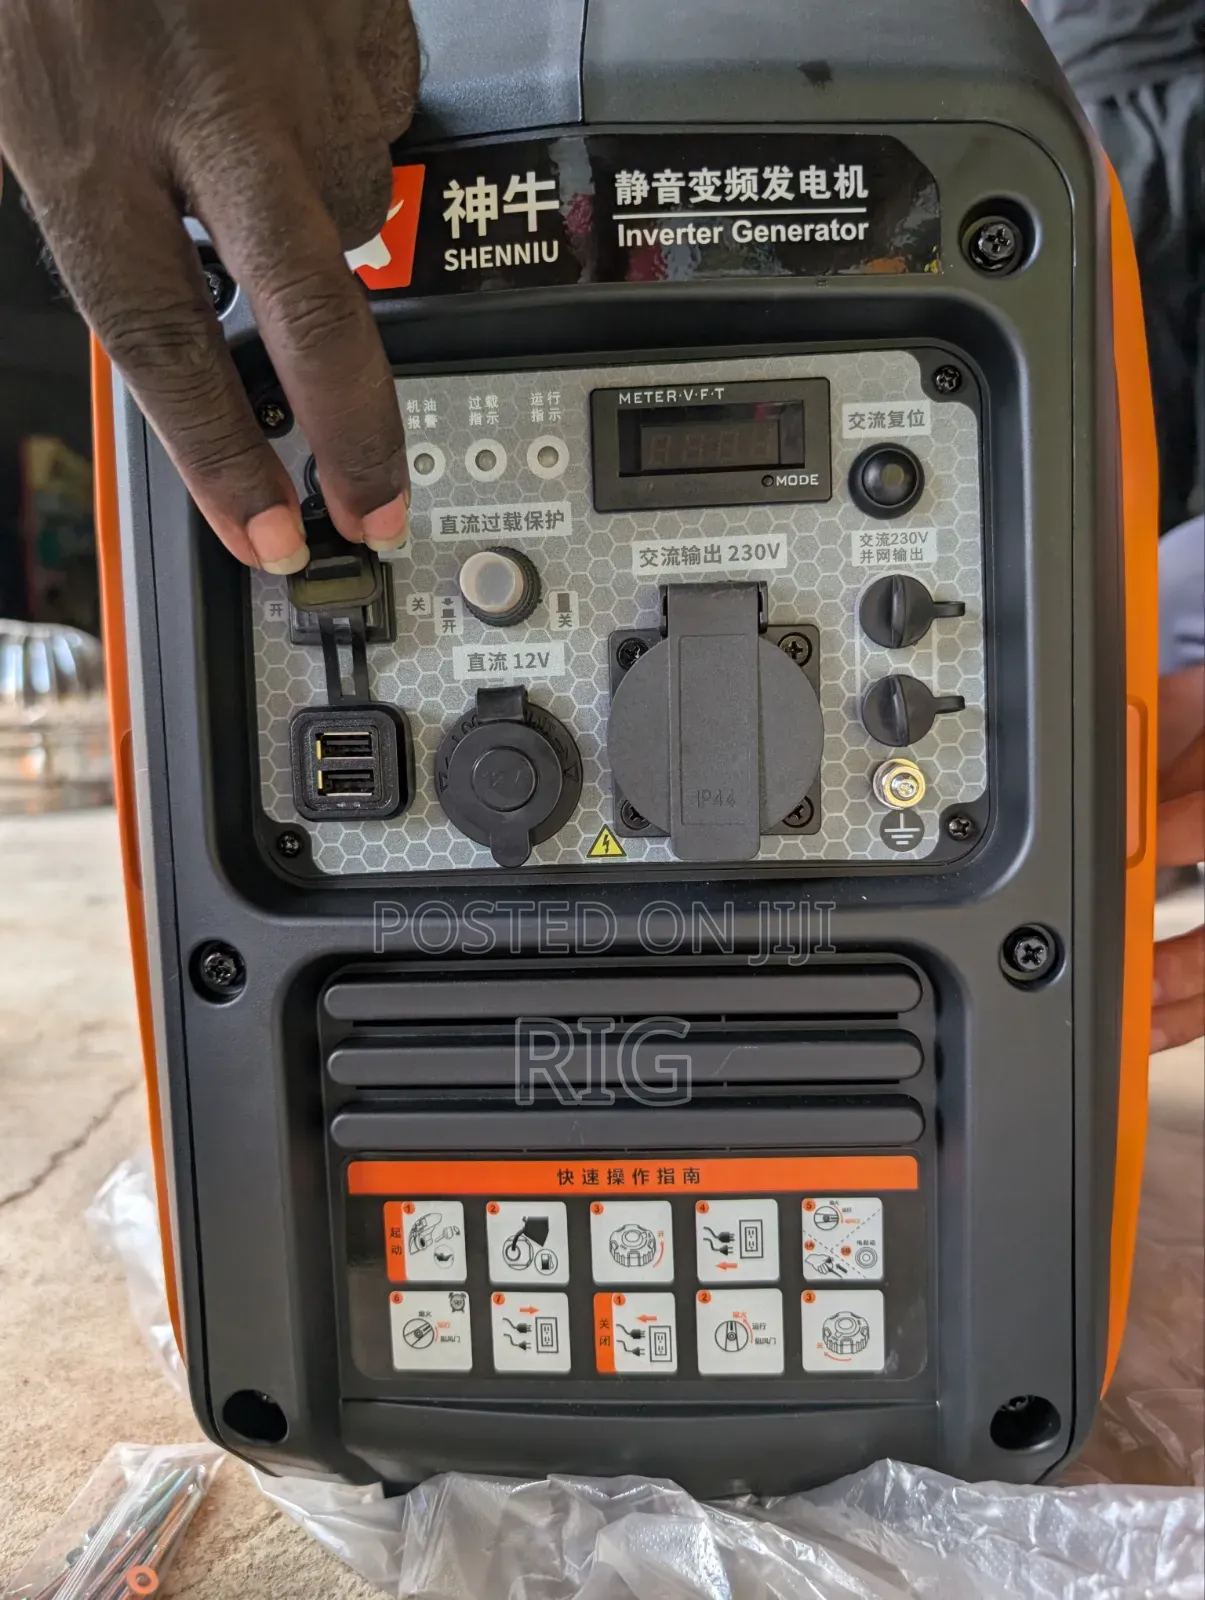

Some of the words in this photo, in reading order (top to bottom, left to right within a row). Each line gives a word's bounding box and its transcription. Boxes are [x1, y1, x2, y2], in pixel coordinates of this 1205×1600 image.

[614, 164, 869, 206] 静音变频发电机
[442, 171, 560, 238] 神牛
[617, 221, 724, 248] Inverter
[732, 217, 869, 245] Generator
[443, 240, 560, 272] SHENNIU
[406, 399, 437, 413] 机油
[468, 395, 499, 411] 过载
[530, 391, 561, 407] 运行
[469, 411, 500, 426] 指示
[531, 407, 562, 423] 指示
[847, 409, 926, 431] 交流复位
[775, 474, 820, 487] MODE
[439, 509, 565, 535] 直流过载保护
[638, 543, 723, 568] 交流输出
[727, 542, 781, 562] 230V
[859, 547, 924, 563] 并网输出
[269, 603, 284, 616] 开
[411, 598, 426, 612] 关
[442, 620, 457, 633] 开
[557, 614, 573, 628] 关
[467, 653, 508, 672] 直流
[513, 652, 551, 670] 12V
[557, 1166, 701, 1186] 快速操作指南
